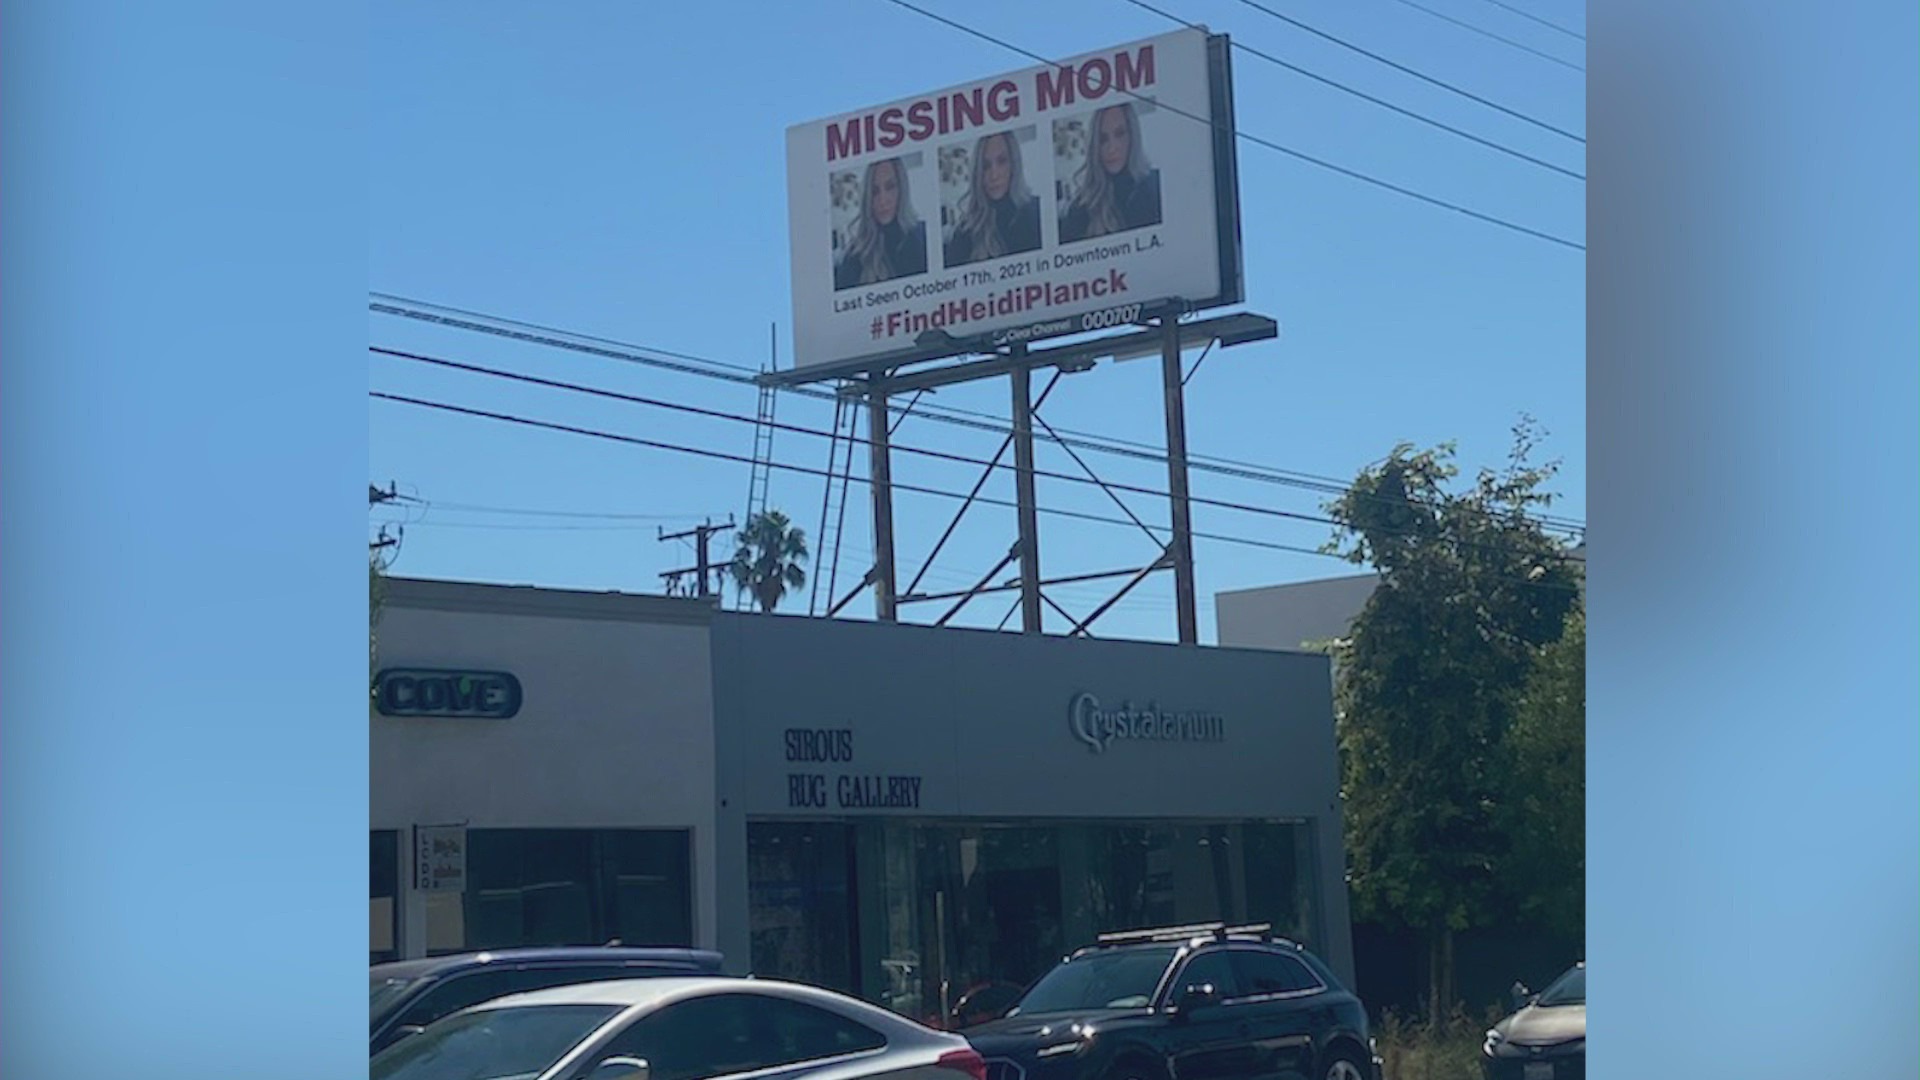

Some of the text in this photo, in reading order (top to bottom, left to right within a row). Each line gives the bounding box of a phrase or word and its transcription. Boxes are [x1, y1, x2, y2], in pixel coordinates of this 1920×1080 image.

[827, 45, 1156, 162] MISSING MOM
[834, 296, 863, 313] Last
[866, 289, 899, 307] Seen
[903, 278, 957, 299] October
[999, 262, 1031, 280] 2021
[1036, 259, 1050, 272] in
[1054, 243, 1131, 269] Downtown
[1135, 234, 1164, 252] L.A.
[870, 268, 1128, 340] #FindHeidiPlanck
[1082, 303, 1142, 331] 000707
[386, 676, 508, 712] COVE
[784, 728, 853, 763] SIROUS
[787, 773, 922, 809] RUG GALLERY
